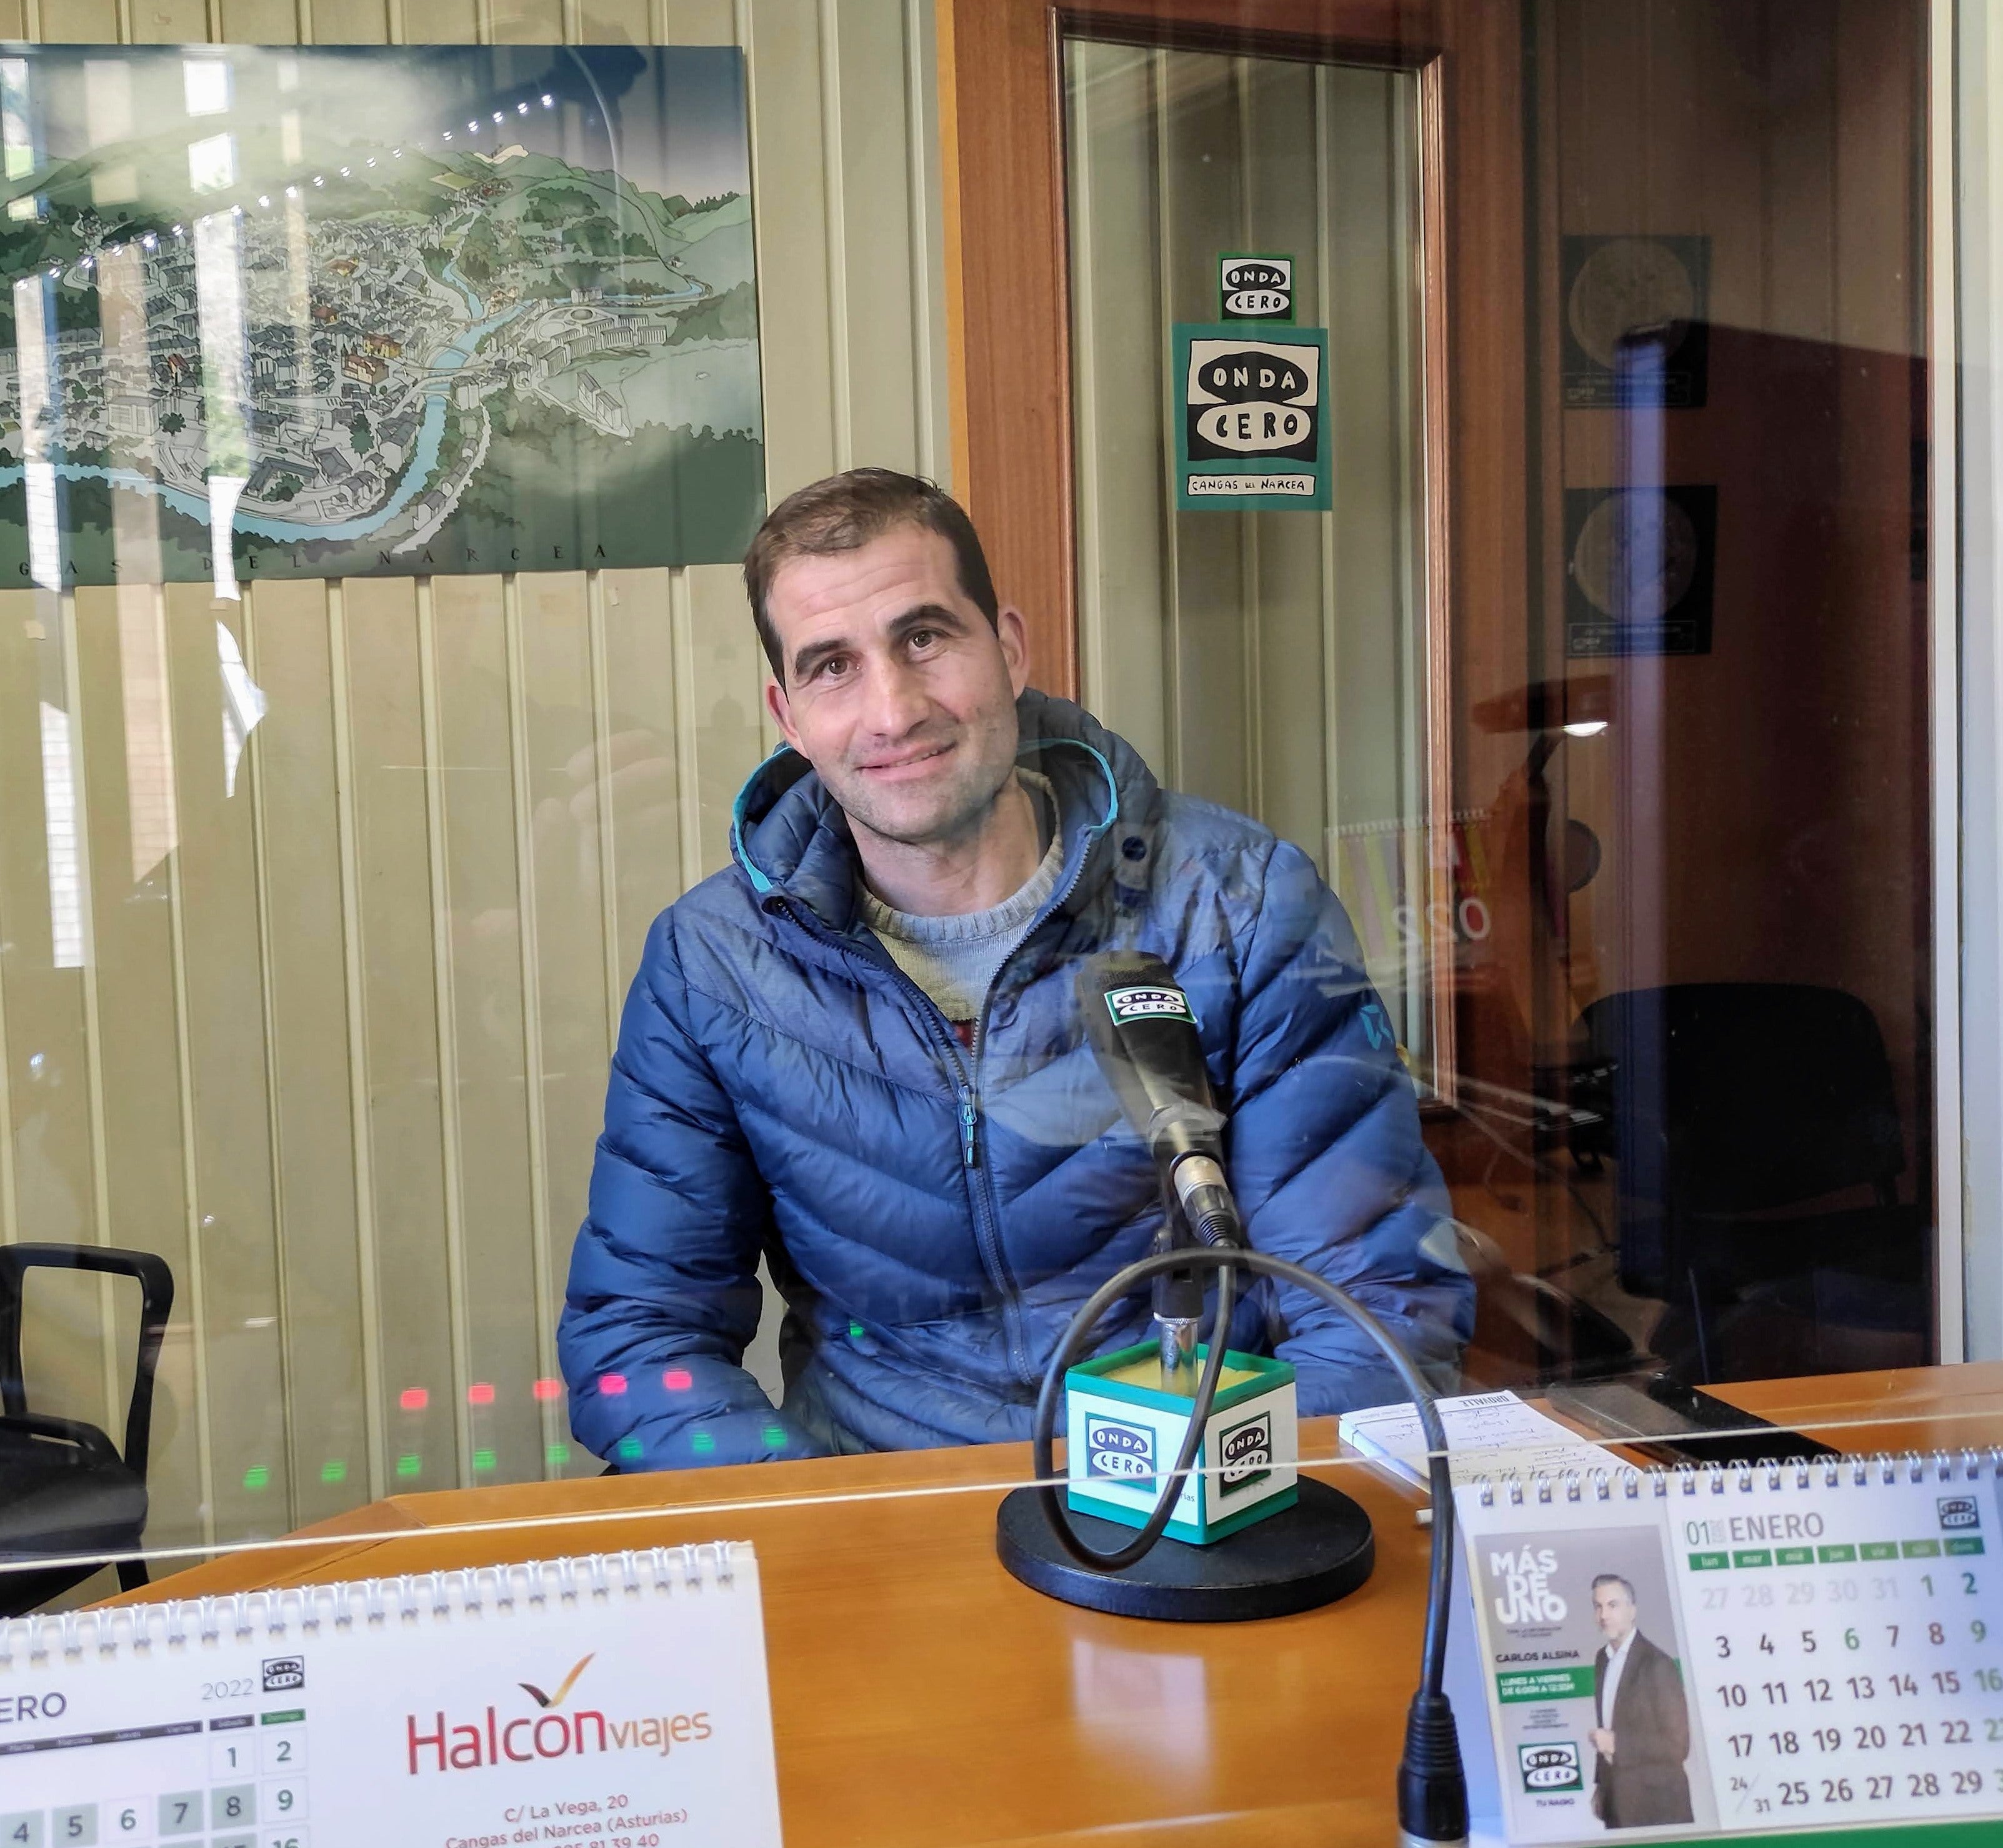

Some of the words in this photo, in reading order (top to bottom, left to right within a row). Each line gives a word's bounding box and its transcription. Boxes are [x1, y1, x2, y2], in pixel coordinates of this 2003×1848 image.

[1231, 270, 1281, 284] ONDA
[1234, 295, 1281, 309] CERO
[1212, 367, 1296, 389] ONDA
[1216, 412, 1297, 439] CERO
[1192, 480, 1238, 491] CANGAS
[1261, 478, 1305, 491] NARCEA
[379, 543, 607, 565] NARCEA
[1122, 993, 1174, 1003] ONDA
[1097, 1431, 1143, 1451] ONDA
[1228, 1431, 1262, 1456] ONDA
[1101, 1454, 1143, 1474] CERO
[1686, 1521, 1710, 1546] 01
[1729, 1512, 1824, 1542] ENERO
[1490, 1544, 1559, 1577] MÁS
[1506, 1573, 1551, 1597] DE
[1701, 1586, 1728, 1610] 27
[1741, 1583, 1774, 1607] 28
[1786, 1581, 1815, 1605] 29
[1826, 1579, 1860, 1602] 30
[1872, 1577, 1899, 1601] 31
[1921, 1574, 1934, 1597] 1
[1961, 1572, 1978, 1595] 2
[1494, 1594, 1567, 1624] UNO
[1716, 1635, 1731, 1658] 3
[1759, 1632, 1774, 1655] 4
[1801, 1629, 1816, 1653] 5
[1844, 1627, 1860, 1650] 6
[1886, 1625, 1899, 1647] 7
[1929, 1622, 1945, 1646] 8
[1970, 1619, 1987, 1643] 9
[1496, 1652, 1539, 1663] CARLOS
[1542, 1649, 1580, 1660] ALSINA
[201, 1678, 254, 1700] 2022
[1717, 1684, 1747, 1707] 10
[1762, 1681, 1787, 1705] 11
[1804, 1679, 1833, 1702] 12
[1846, 1676, 1875, 1699] 13
[1889, 1672, 1918, 1696] 14
[1931, 1670, 1961, 1694] 15
[1973, 1667, 2002, 1692] 16
[1728, 1734, 1752, 1757] 17
[1769, 1731, 1800, 1754] 18
[1812, 1728, 1842, 1752] 19
[1854, 1725, 1886, 1749] 20
[1899, 1723, 1927, 1746] 21
[1941, 1720, 1973, 1744] 22
[227, 1747, 236, 1767] 1
[276, 1740, 292, 1762] 2
[1729, 1776, 1747, 1791] 24
[1754, 1798, 1771, 1813] 31
[1777, 1781, 1810, 1805] 25
[1821, 1778, 1853, 1802] 26
[1866, 1776, 1893, 1800] 27
[1907, 1772, 1941, 1797] 28
[1951, 1770, 1983, 1794] 29
[12, 1821, 30, 1843] 4
[68, 1815, 83, 1837] 5
[121, 1808, 136, 1831] 6
[173, 1802, 189, 1824] 7
[226, 1795, 241, 1817] 8
[277, 1789, 294, 1811] 9
[504, 1804, 524, 1823] C/
[531, 1806, 550, 1819] La
[607, 1794, 629, 1809] 20
[446, 1834, 507, 1848] Cangas
[512, 1826, 539, 1843] del
[544, 1821, 602, 1838] Narcea
[607, 1808, 688, 1833] (Asturias)
[637, 1832, 660, 1847] 40
